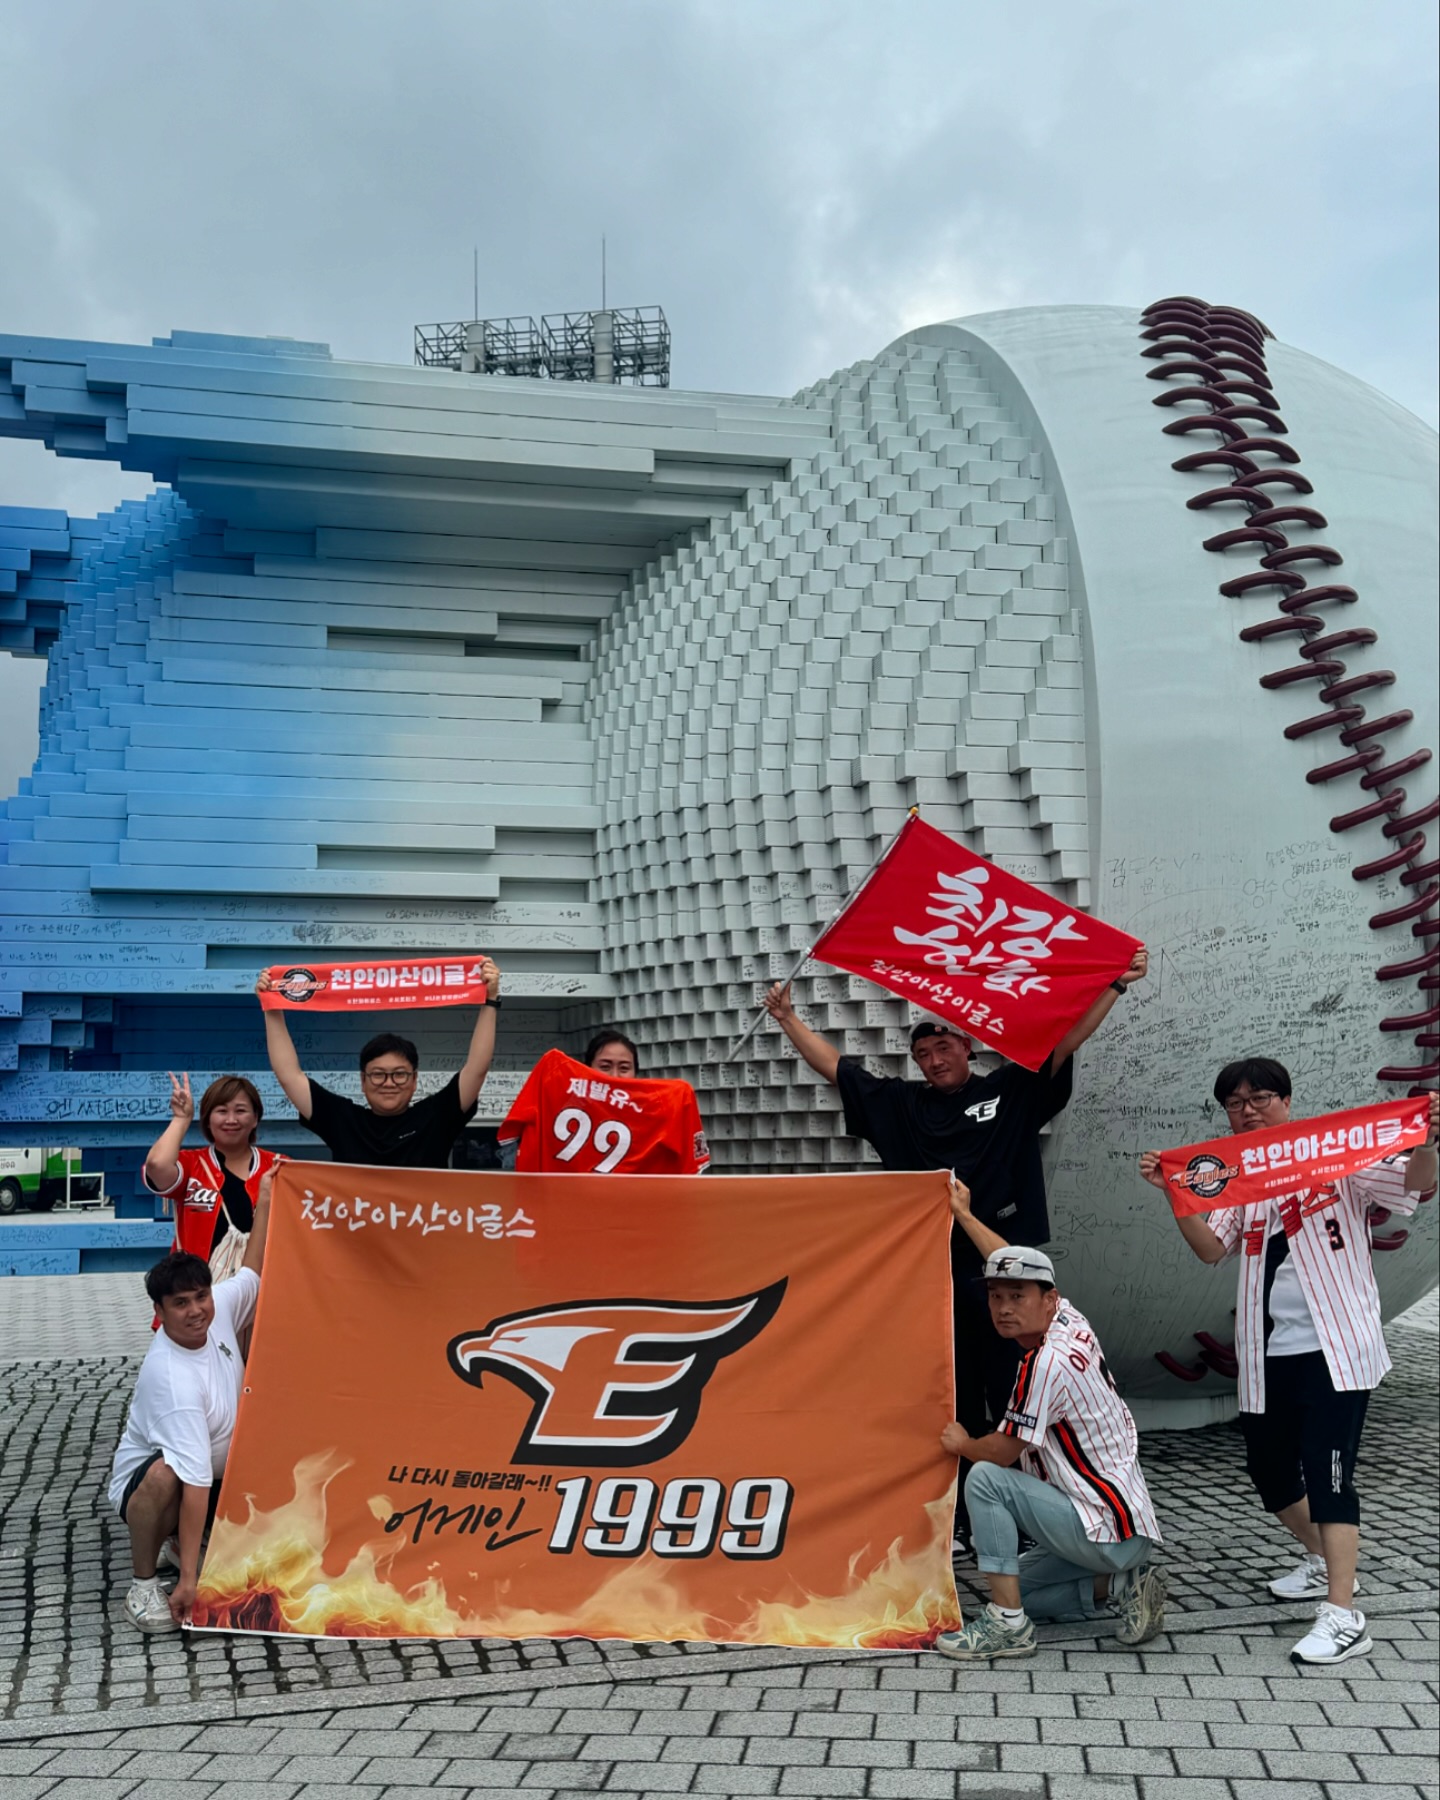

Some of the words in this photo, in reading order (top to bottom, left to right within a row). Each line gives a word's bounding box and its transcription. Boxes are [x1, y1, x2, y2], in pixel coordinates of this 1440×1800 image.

[926, 867, 1089, 958] 최강
[893, 925, 1051, 999] 한화
[870, 959, 1005, 1036] 천안아산이글스
[567, 1078, 643, 1113] 제발유~
[553, 1108, 631, 1173] 99
[1241, 1113, 1429, 1176] 천안아산이글스
[1170, 1165, 1240, 1189] Eagles
[301, 1189, 536, 1240] 천안아산이글스
[1325, 1218, 1345, 1251] 3
[388, 1465, 408, 1484] 나
[411, 1467, 449, 1487] 다시
[452, 1470, 552, 1493] 돌아갈래~!!
[384, 1496, 543, 1551] 어게인
[547, 1476, 795, 1561] 1999
